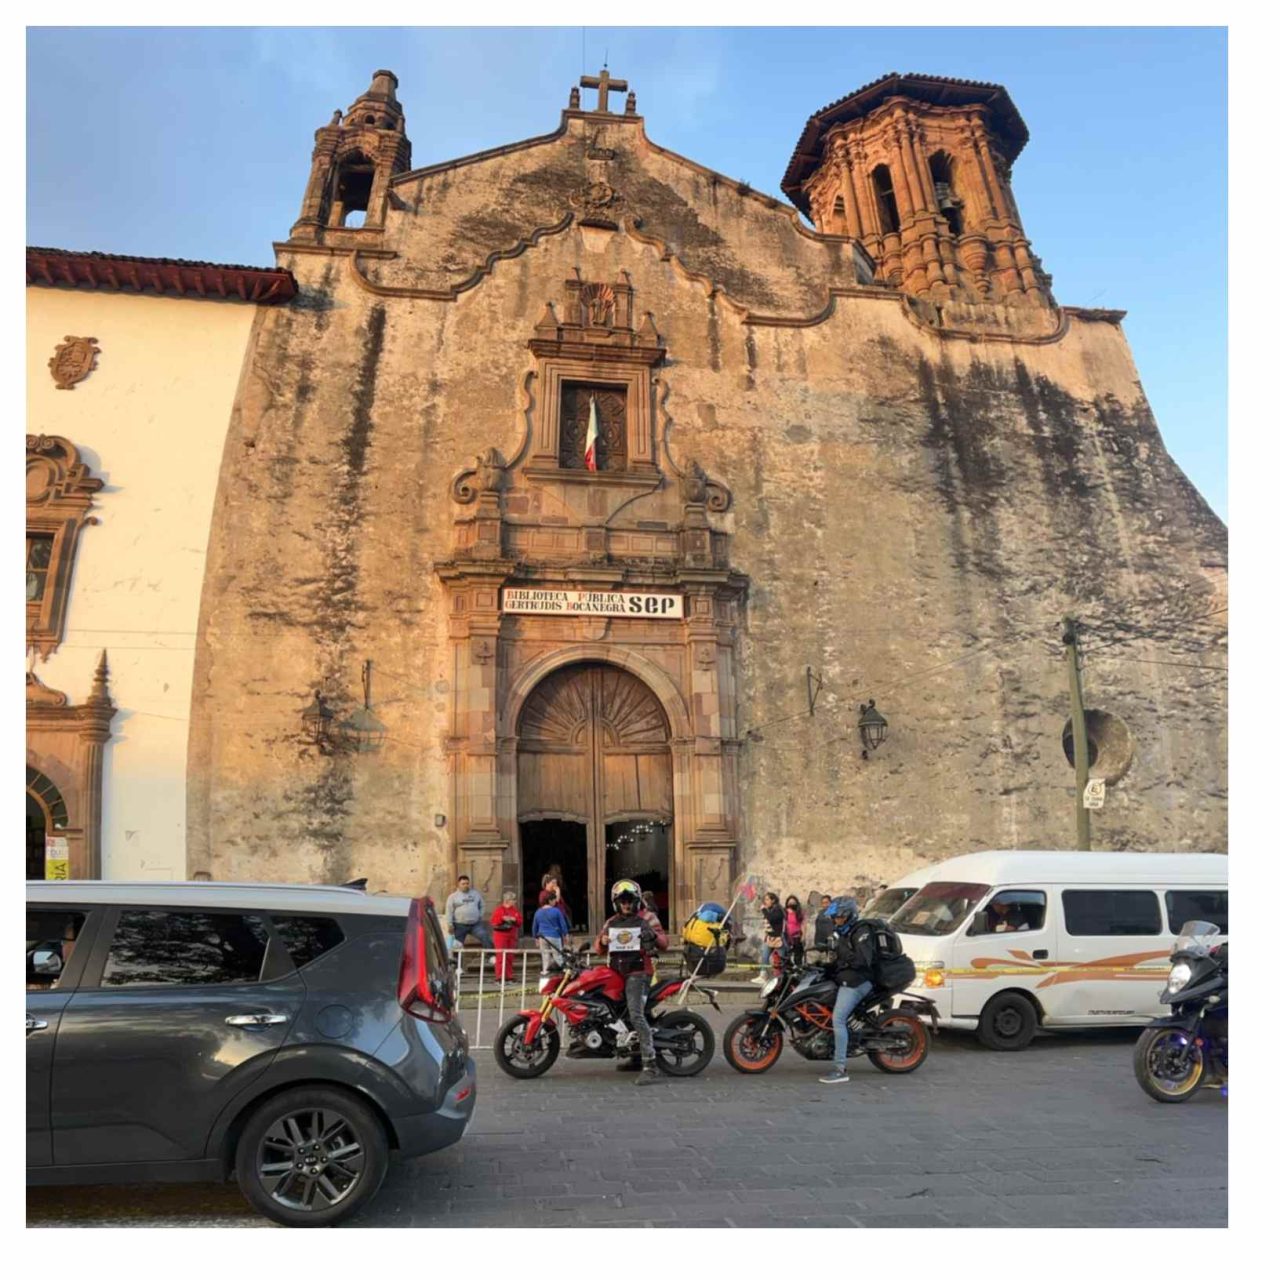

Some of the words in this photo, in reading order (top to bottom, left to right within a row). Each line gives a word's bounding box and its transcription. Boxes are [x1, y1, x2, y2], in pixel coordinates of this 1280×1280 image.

[507, 590, 568, 602] BIBLIOTECA
[505, 600, 562, 610] GERTRUDIS
[566, 602, 626, 613] BOCANEGRA
